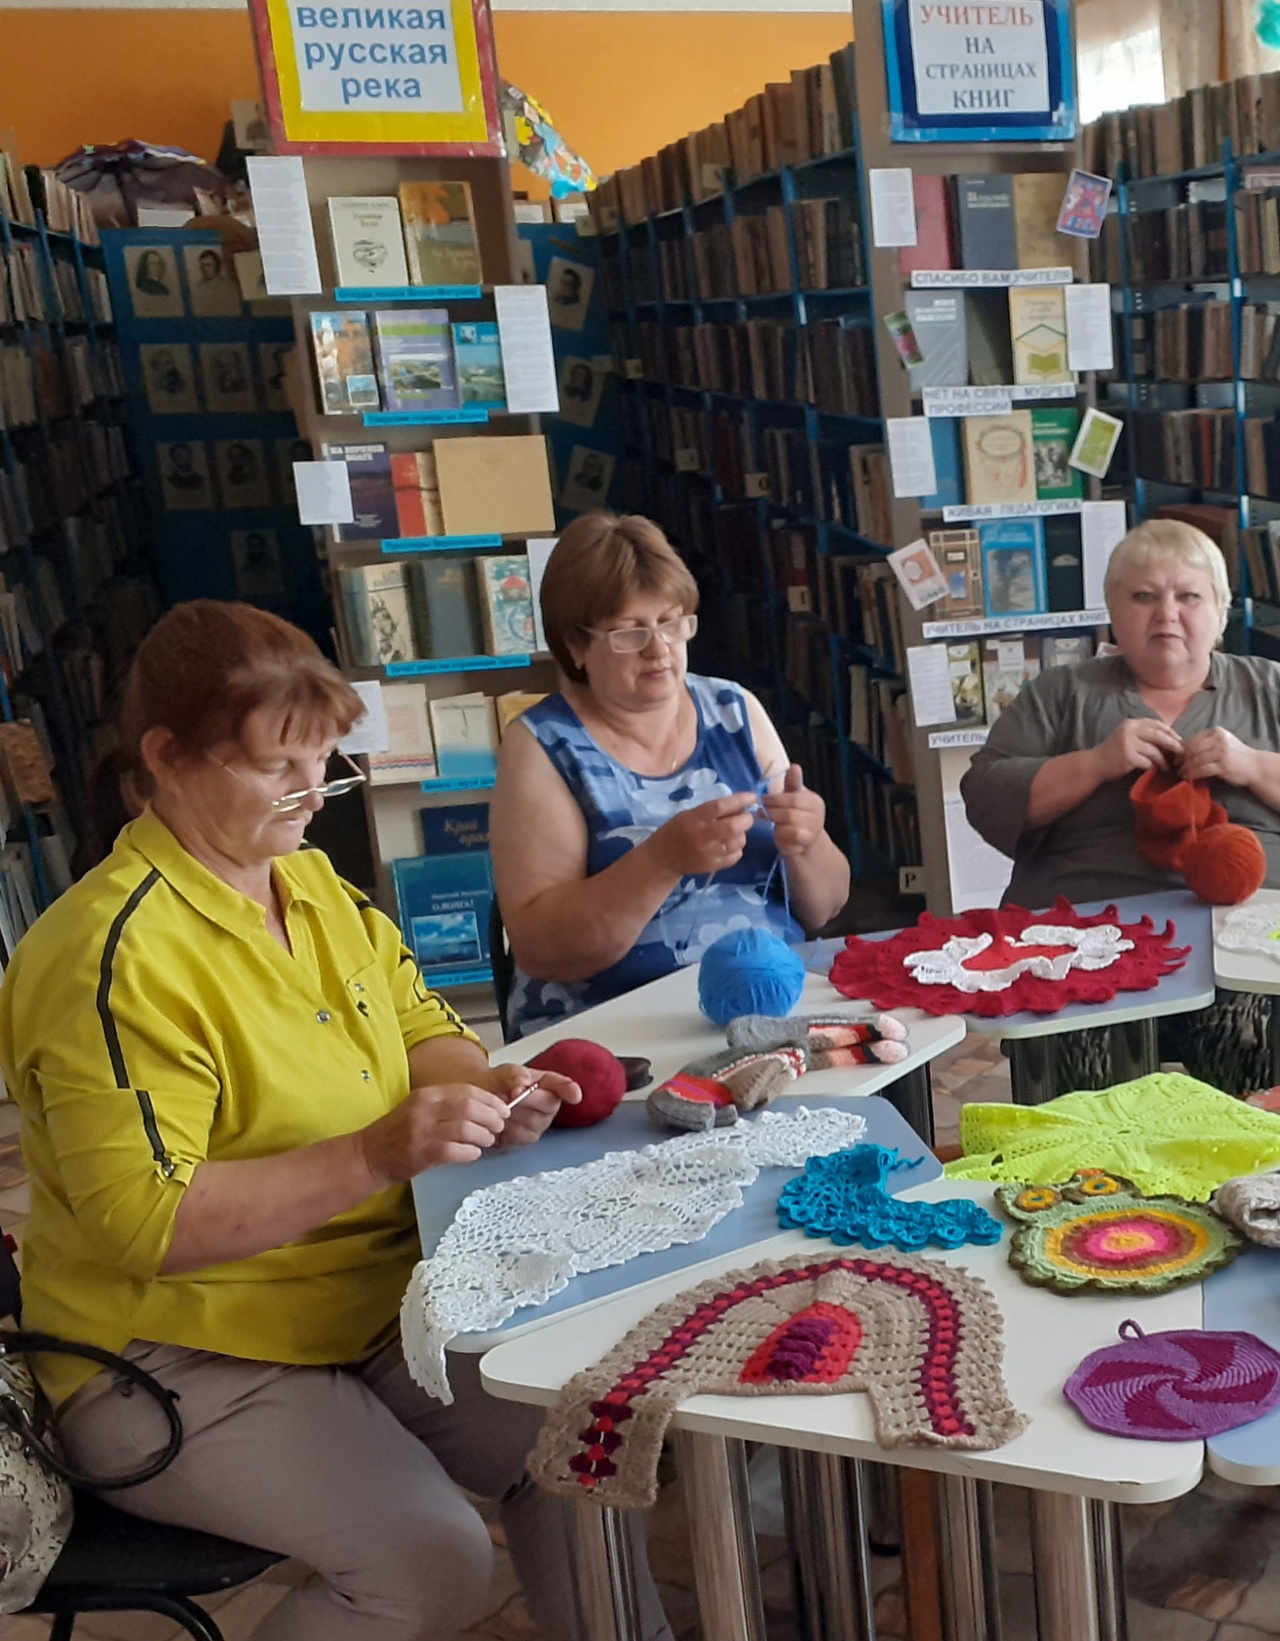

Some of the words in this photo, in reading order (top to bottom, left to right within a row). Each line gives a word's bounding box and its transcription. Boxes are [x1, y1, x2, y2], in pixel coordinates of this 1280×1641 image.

[297, 6, 446, 30] великая
[920, 5, 1034, 26] УЧИТЕЛЬ
[964, 36, 995, 55] НА
[304, 42, 448, 71] русская
[925, 62, 1038, 80] СТРАНИЦАХ
[340, 76, 422, 105] река
[952, 89, 1015, 110] КНИГ
[914, 272, 980, 285] СПАСИБО
[952, 388, 971, 400] НА
[928, 402, 1009, 415] ПРОФЕССИИ
[999, 502, 1081, 517] ПЕДАГОГИКА
[925, 623, 981, 636] УЧИТЕЛЬ
[983, 620, 1003, 631] НА
[1005, 614, 1076, 631] СТРАНИЦАХ
